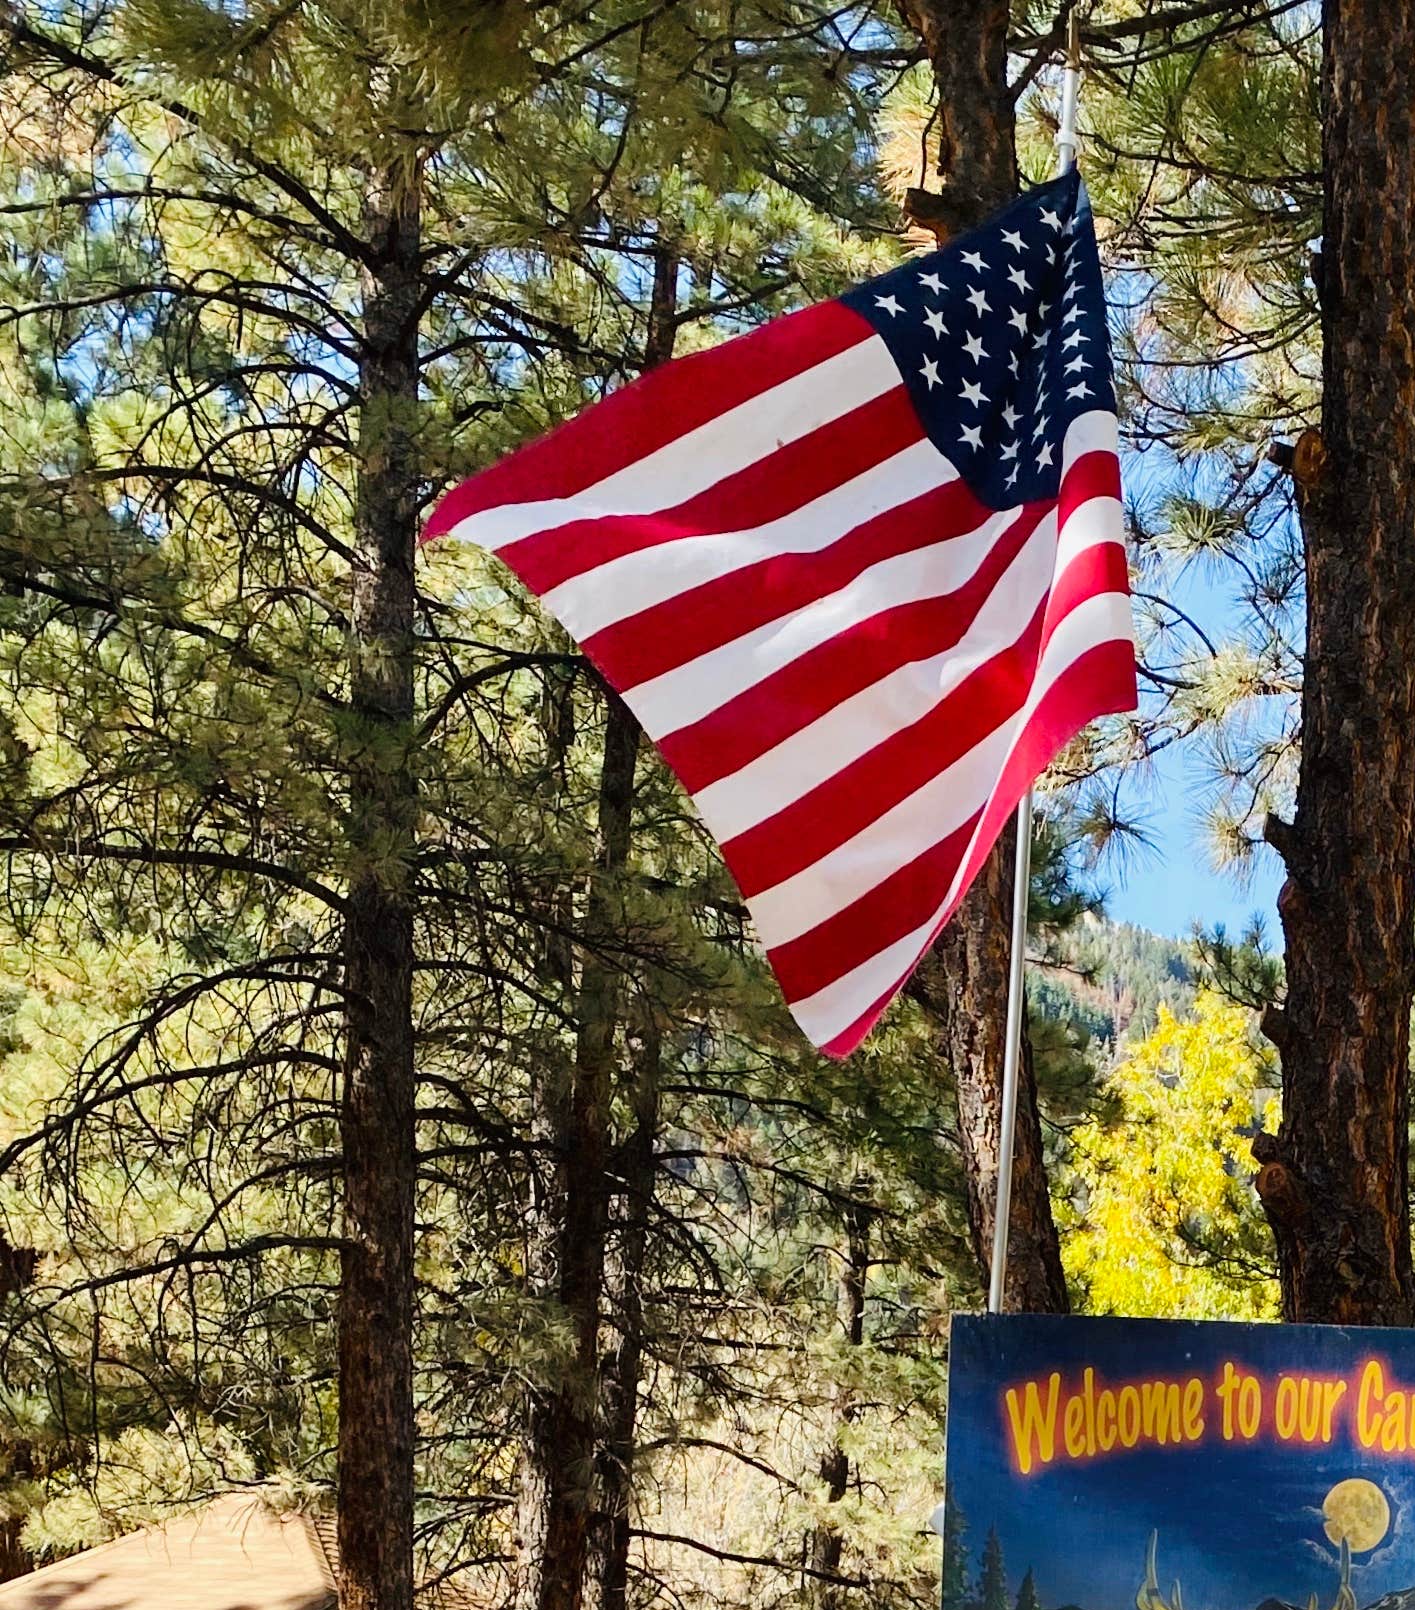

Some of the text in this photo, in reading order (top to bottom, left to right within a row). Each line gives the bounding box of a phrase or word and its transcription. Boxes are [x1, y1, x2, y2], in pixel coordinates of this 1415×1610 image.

[1006, 1367, 1203, 1473] Welcome
[1216, 1362, 1261, 1440] to
[1275, 1377, 1346, 1441] our
